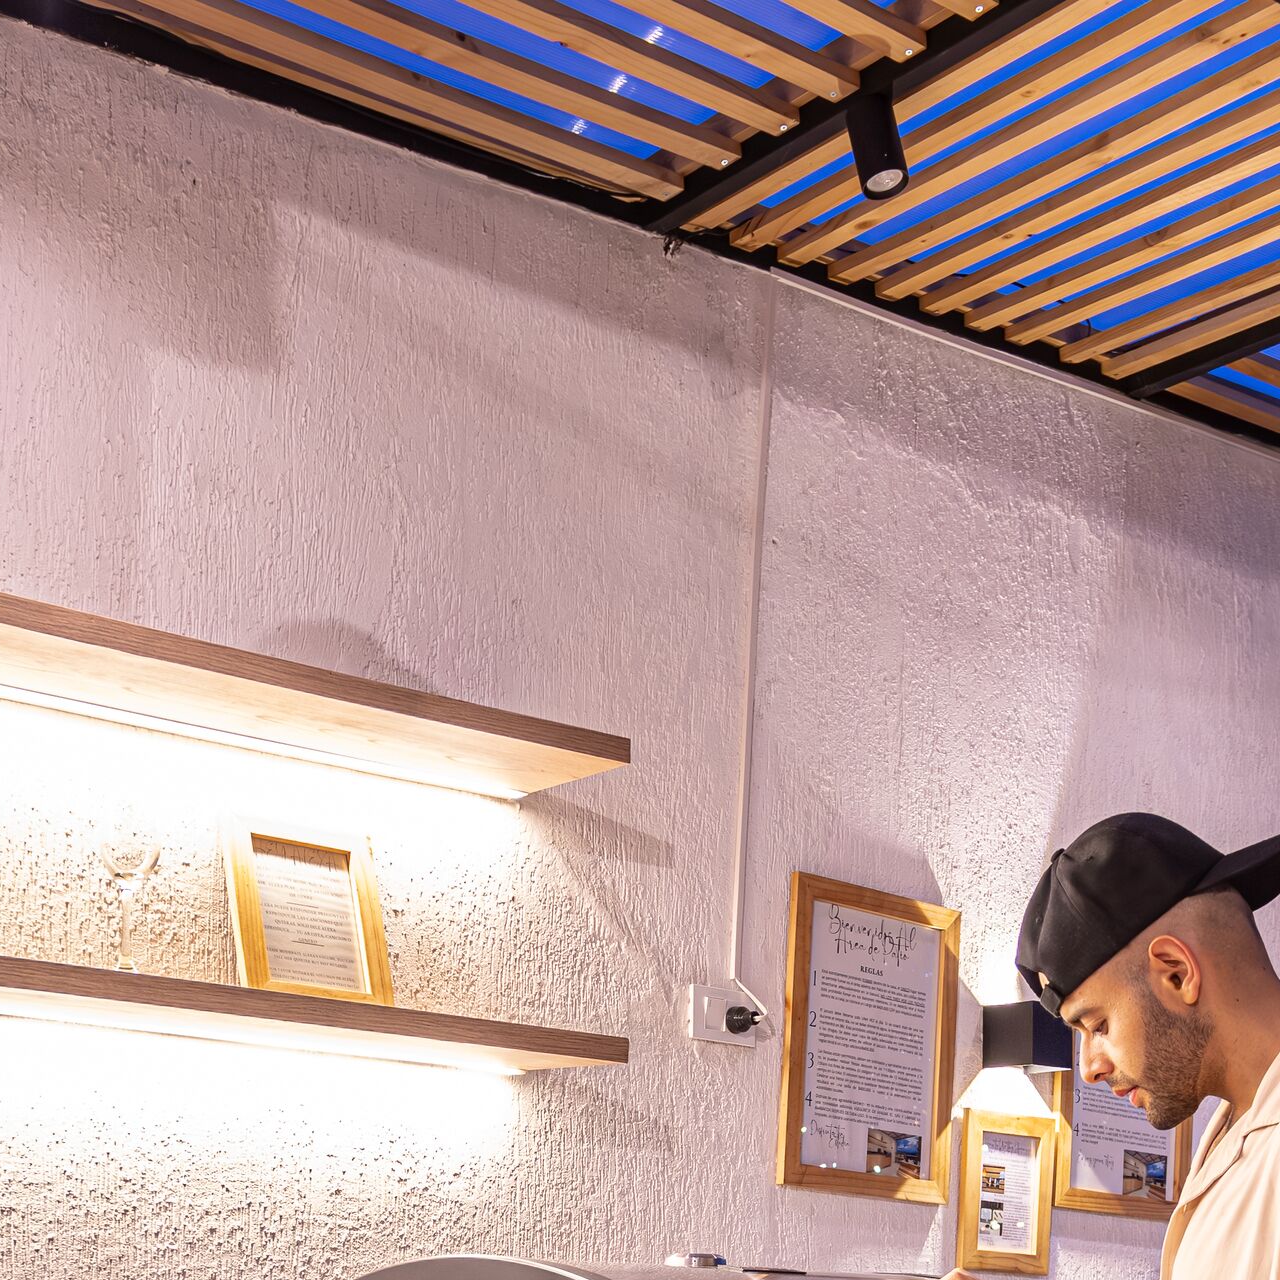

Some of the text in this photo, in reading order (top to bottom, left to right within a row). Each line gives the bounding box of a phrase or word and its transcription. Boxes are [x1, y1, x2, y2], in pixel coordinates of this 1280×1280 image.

[860, 965, 884, 977] REGLAS
[809, 1010, 817, 1028] 2
[807, 1051, 815, 1069] 3
[805, 1090, 813, 1107] 4
[1073, 1122, 1080, 1137] 4
